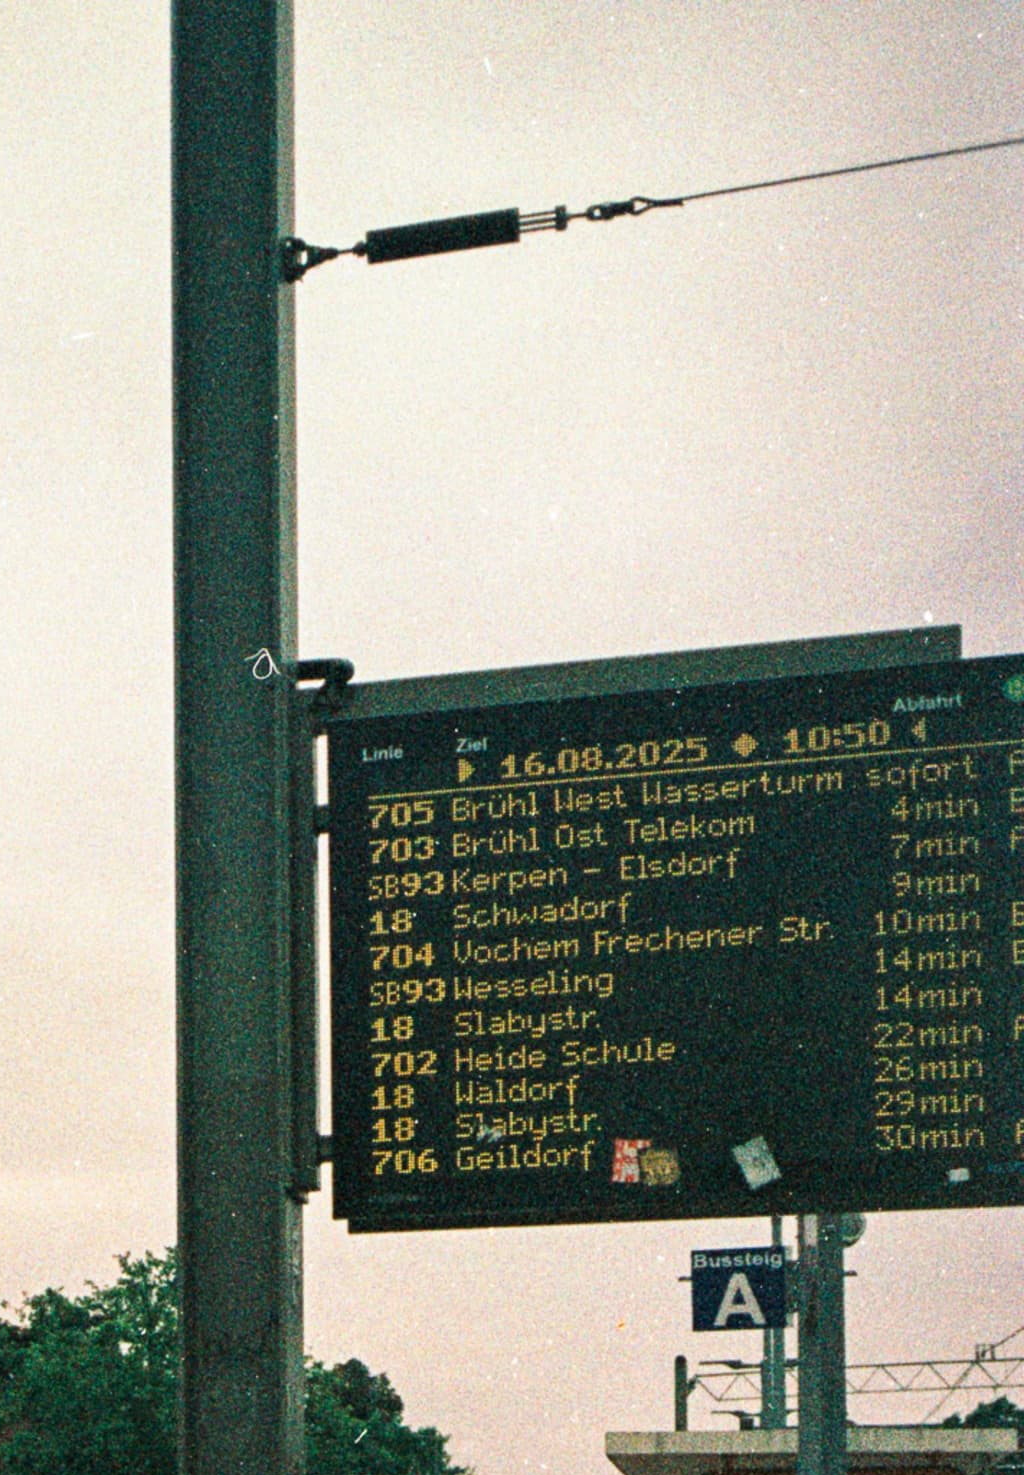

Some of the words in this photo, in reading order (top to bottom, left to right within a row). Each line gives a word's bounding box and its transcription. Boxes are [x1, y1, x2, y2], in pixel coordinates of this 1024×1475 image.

[362, 745, 404, 762] Linie
[456, 737, 488, 753] Ziel
[892, 693, 962, 713] Abfahrt
[501, 737, 708, 778] 16.08.2025
[784, 719, 891, 752] 10:50
[368, 800, 435, 829] 705
[452, 792, 540, 822] Brühl
[554, 784, 627, 813] West
[642, 771, 843, 806] Wasserturm
[866, 754, 977, 790] sofort
[368, 835, 435, 864] 703
[452, 827, 540, 857] Brühl
[556, 822, 607, 849] Ost
[624, 814, 755, 844] Telekom
[368, 871, 444, 900] SB93
[452, 867, 568, 895] Kerpen
[620, 847, 740, 880] Elsdorf
[369, 908, 412, 935] 18
[452, 892, 632, 928] Schwadorf
[369, 942, 435, 970] 704
[454, 937, 580, 964] Vochem
[593, 925, 764, 955] Frechener
[370, 977, 446, 1007] SB93
[454, 969, 614, 1000] Wesseling
[371, 1015, 414, 1042] 18
[455, 1005, 601, 1038] Slabystr.
[371, 1049, 437, 1077] 702
[455, 1044, 547, 1072] Heide
[561, 1036, 677, 1066] Schule
[372, 1083, 415, 1110] 18
[455, 1074, 580, 1105] Waldorf
[372, 1116, 415, 1143] 18
[456, 1107, 602, 1141] Slabystr.
[372, 1148, 439, 1175] 706
[456, 1139, 595, 1171] Geildorf
[693, 1252, 783, 1269] Bussteig
[713, 1271, 767, 1327] A
